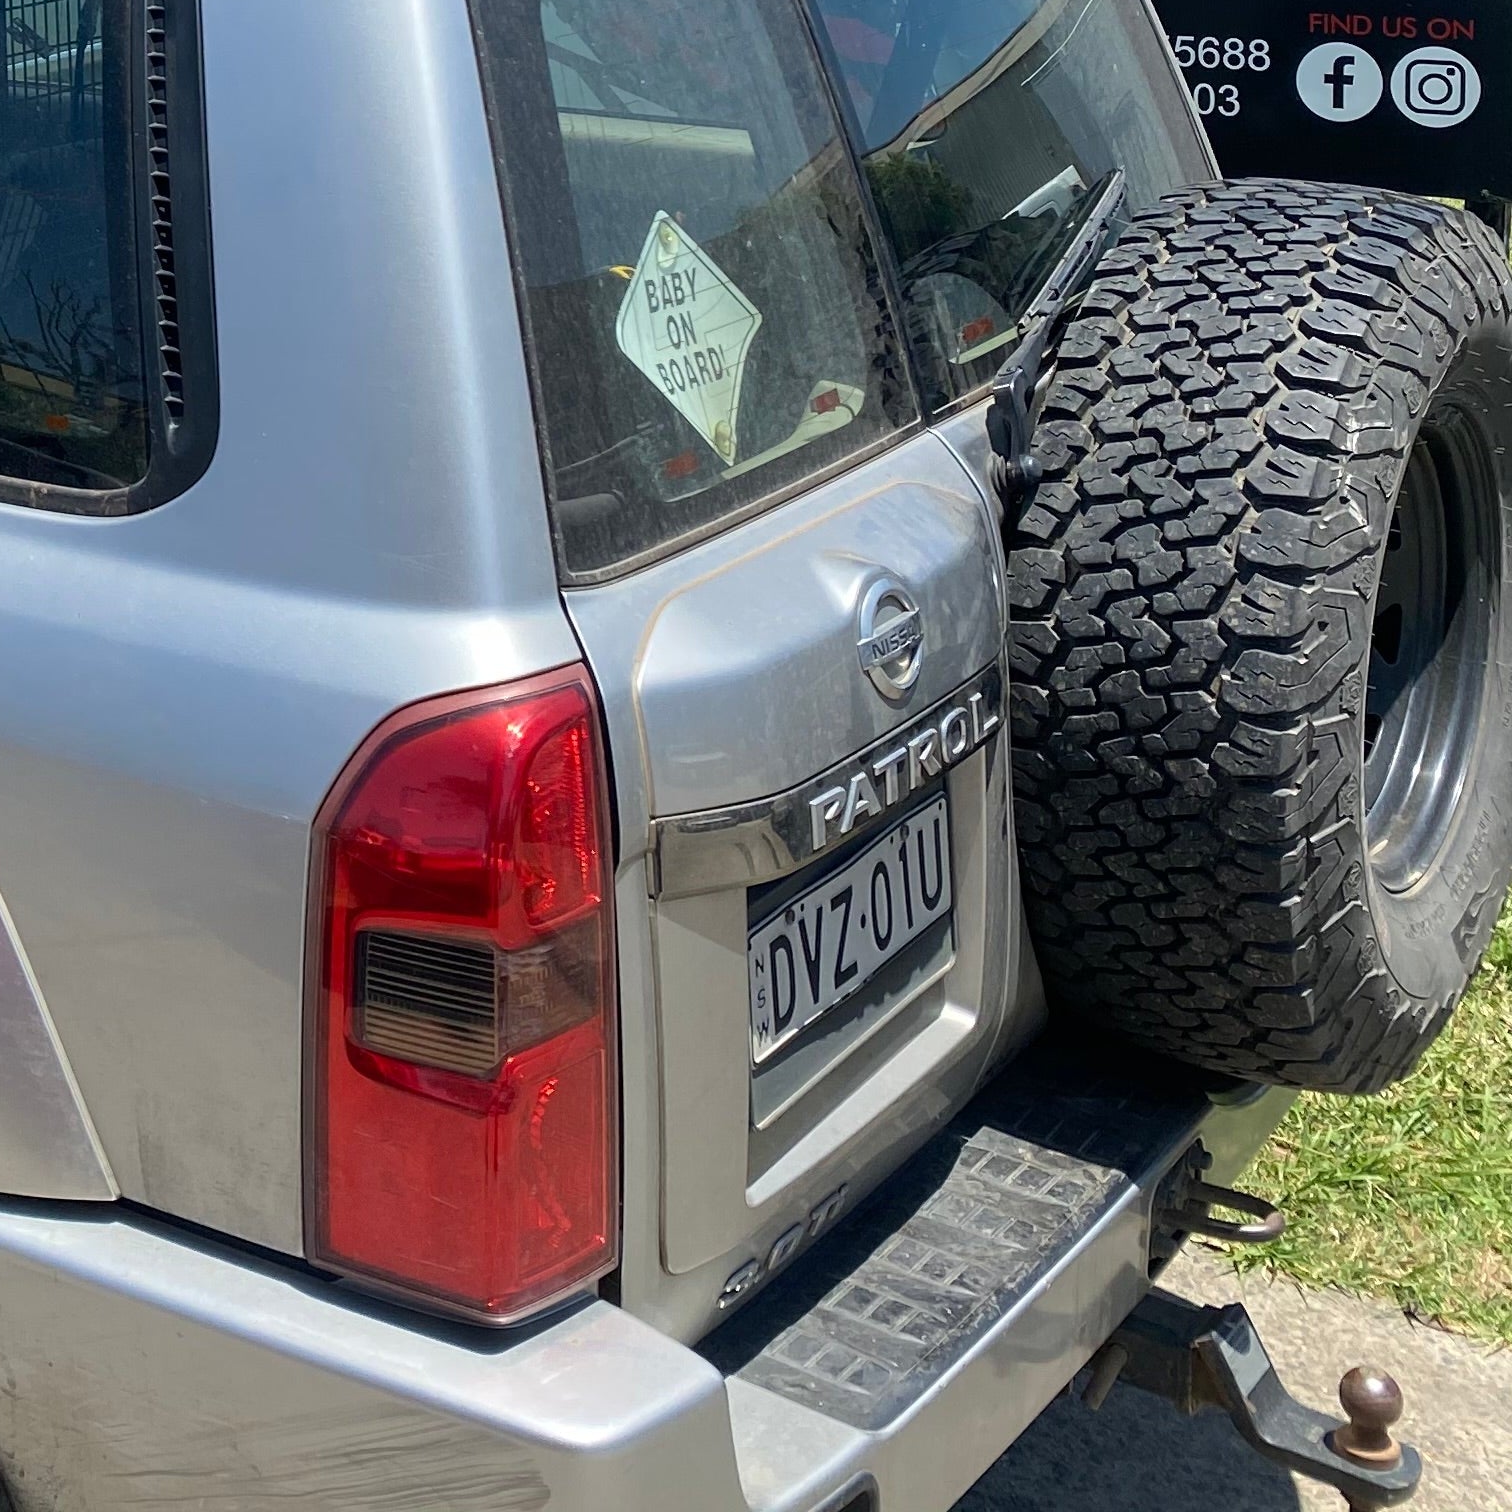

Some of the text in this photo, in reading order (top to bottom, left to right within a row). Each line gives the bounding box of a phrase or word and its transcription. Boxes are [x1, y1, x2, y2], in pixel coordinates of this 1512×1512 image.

[1309, 13, 1475, 40] FIND US ON
[1166, 35, 1271, 72] 5688
[644, 267, 697, 314] BABY
[666, 309, 699, 351] ON
[809, 691, 999, 851] PATROL
